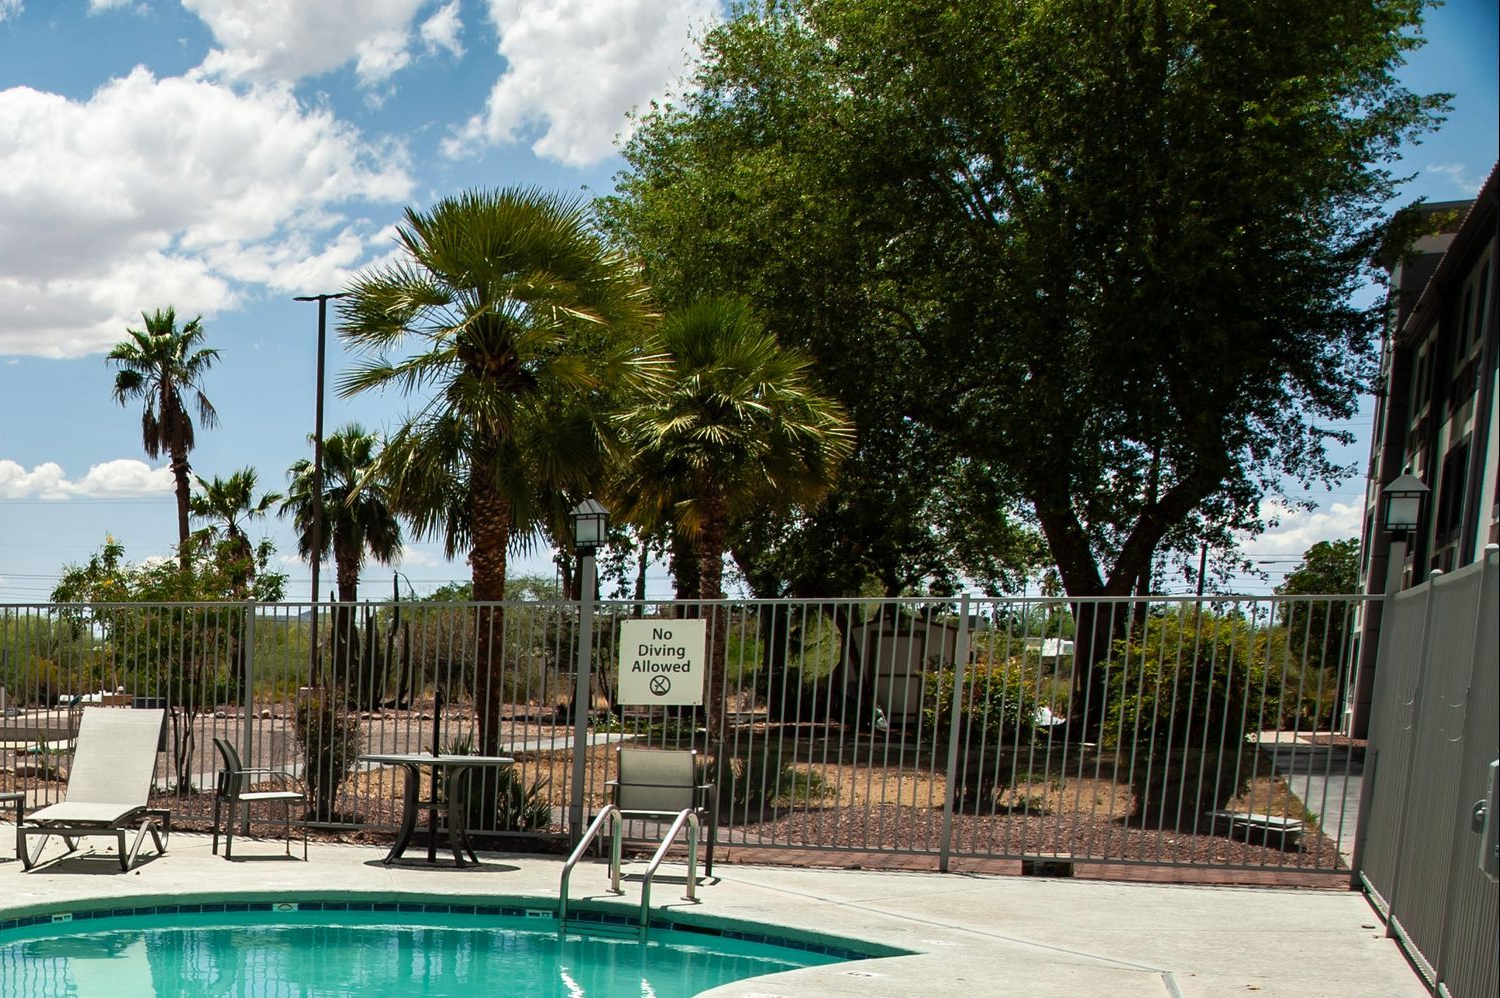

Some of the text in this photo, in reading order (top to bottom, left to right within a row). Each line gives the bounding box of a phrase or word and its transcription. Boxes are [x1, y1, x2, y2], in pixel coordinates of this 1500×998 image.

[652, 628, 673, 641] No
[638, 644, 686, 660] Diving
[631, 660, 691, 673] Allowed
